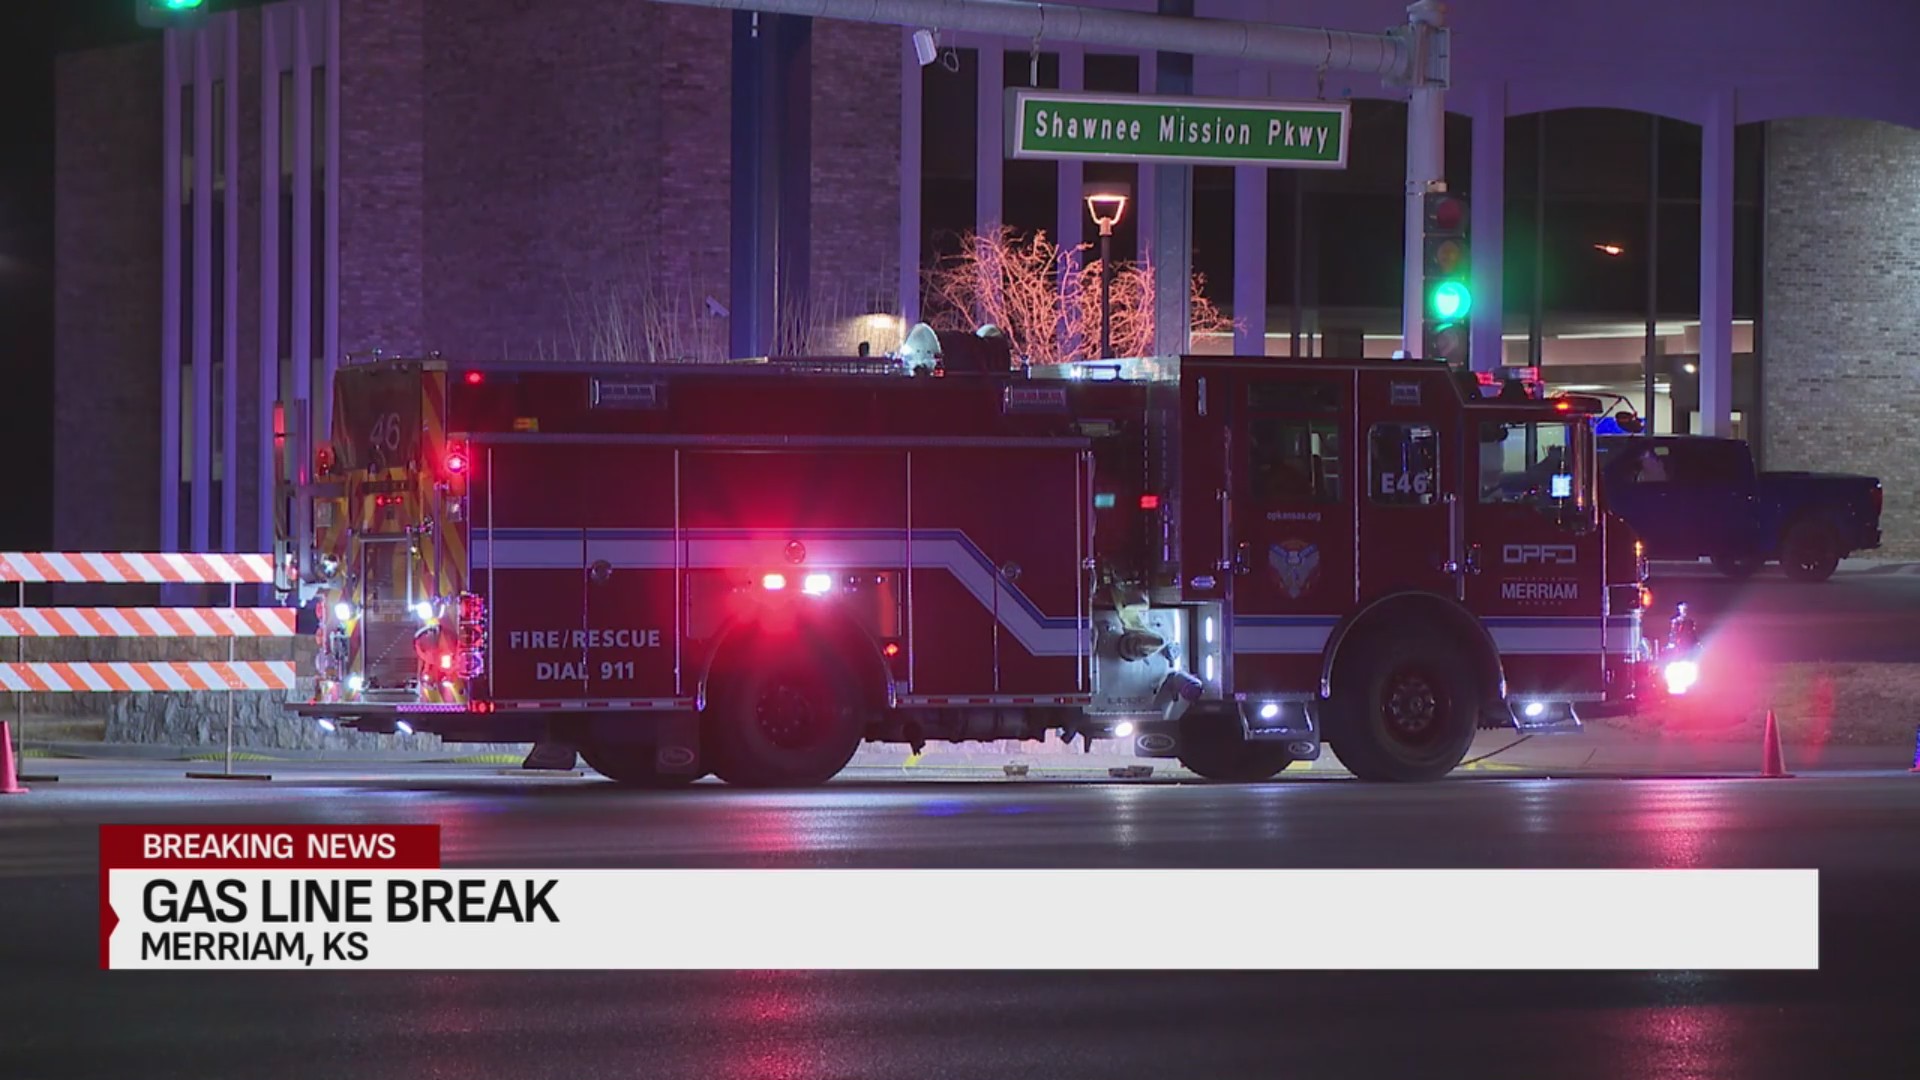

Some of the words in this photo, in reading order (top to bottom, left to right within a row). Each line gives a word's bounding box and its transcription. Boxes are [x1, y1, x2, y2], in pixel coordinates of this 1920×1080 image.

[1035, 109, 1141, 140] Shawnee
[1159, 114, 1250, 145] Mission
[1268, 119, 1328, 154] Pkwy
[370, 413, 400, 450] 46
[1381, 472, 1427, 494] E46
[1503, 544, 1576, 564] OPFD
[1502, 583, 1577, 599] MERRIAM
[510, 629, 661, 649] FIRE/RESCUE
[536, 662, 589, 681] DIAL
[601, 661, 634, 680] 911
